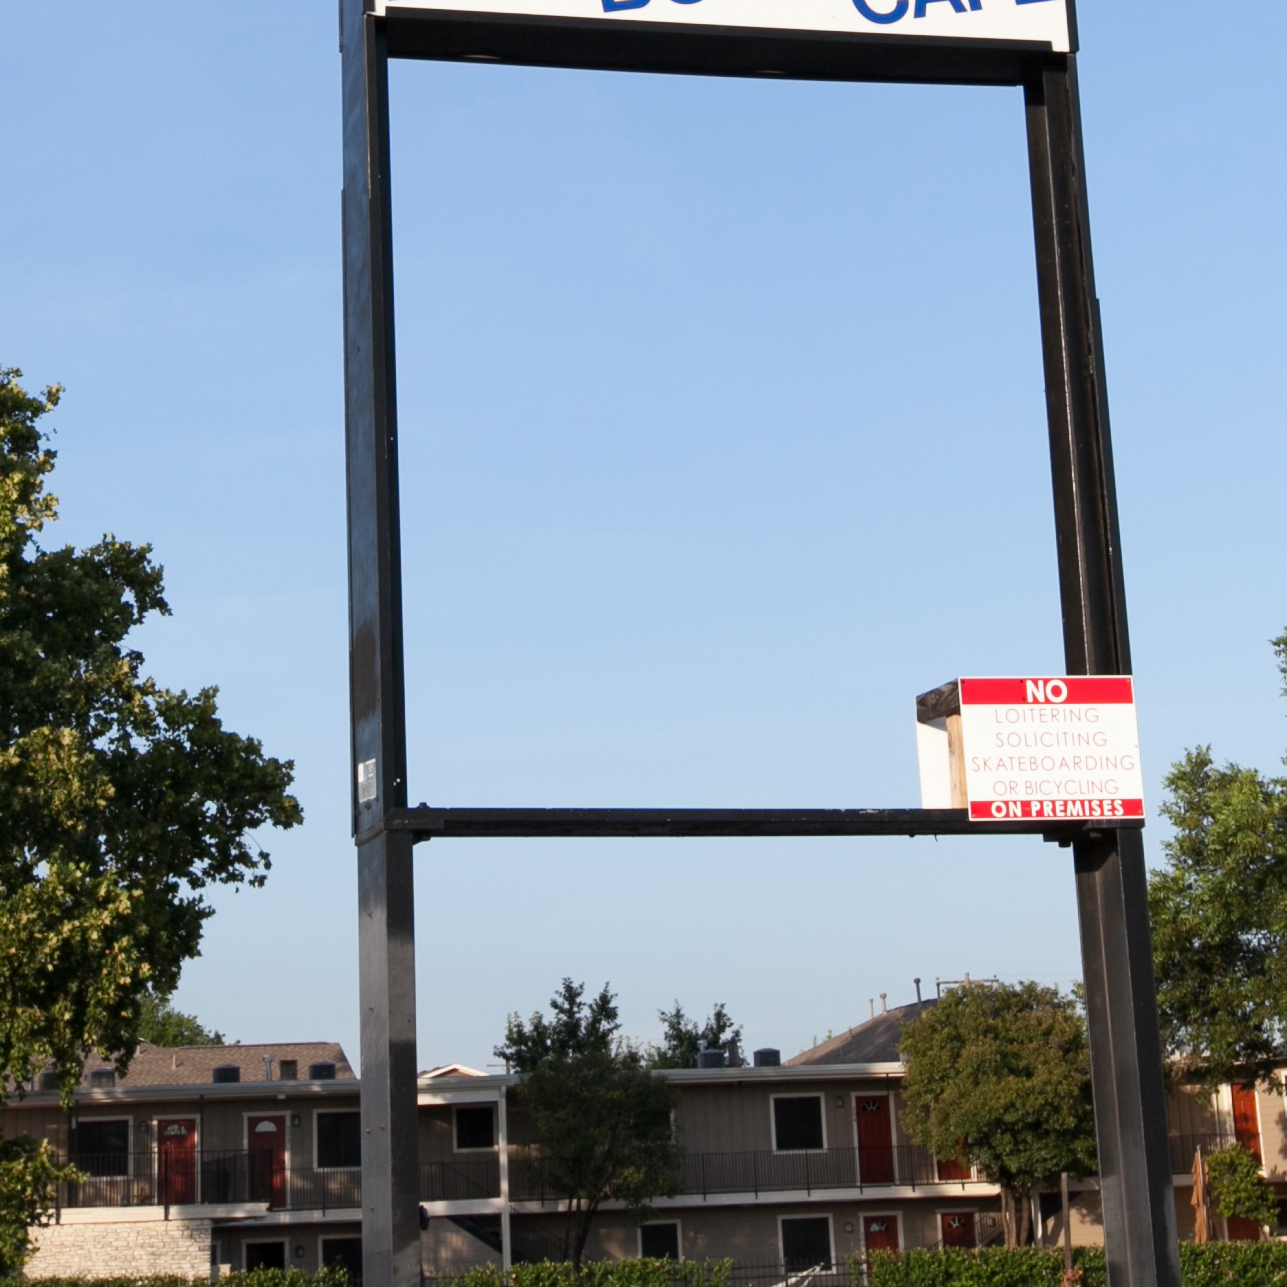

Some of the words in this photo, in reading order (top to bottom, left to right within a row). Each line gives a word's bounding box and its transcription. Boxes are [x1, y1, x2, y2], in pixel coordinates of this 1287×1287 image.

[1025, 679, 1068, 703] NO
[994, 708, 1100, 724] LOITERING
[995, 731, 1107, 748] SOLICITING
[972, 755, 1135, 772] SKATEBOARDING
[992, 780, 1018, 796] OR
[1024, 779, 1119, 796] BICYCLING
[990, 801, 1022, 818] ON
[1030, 799, 1124, 818] PREMISES
